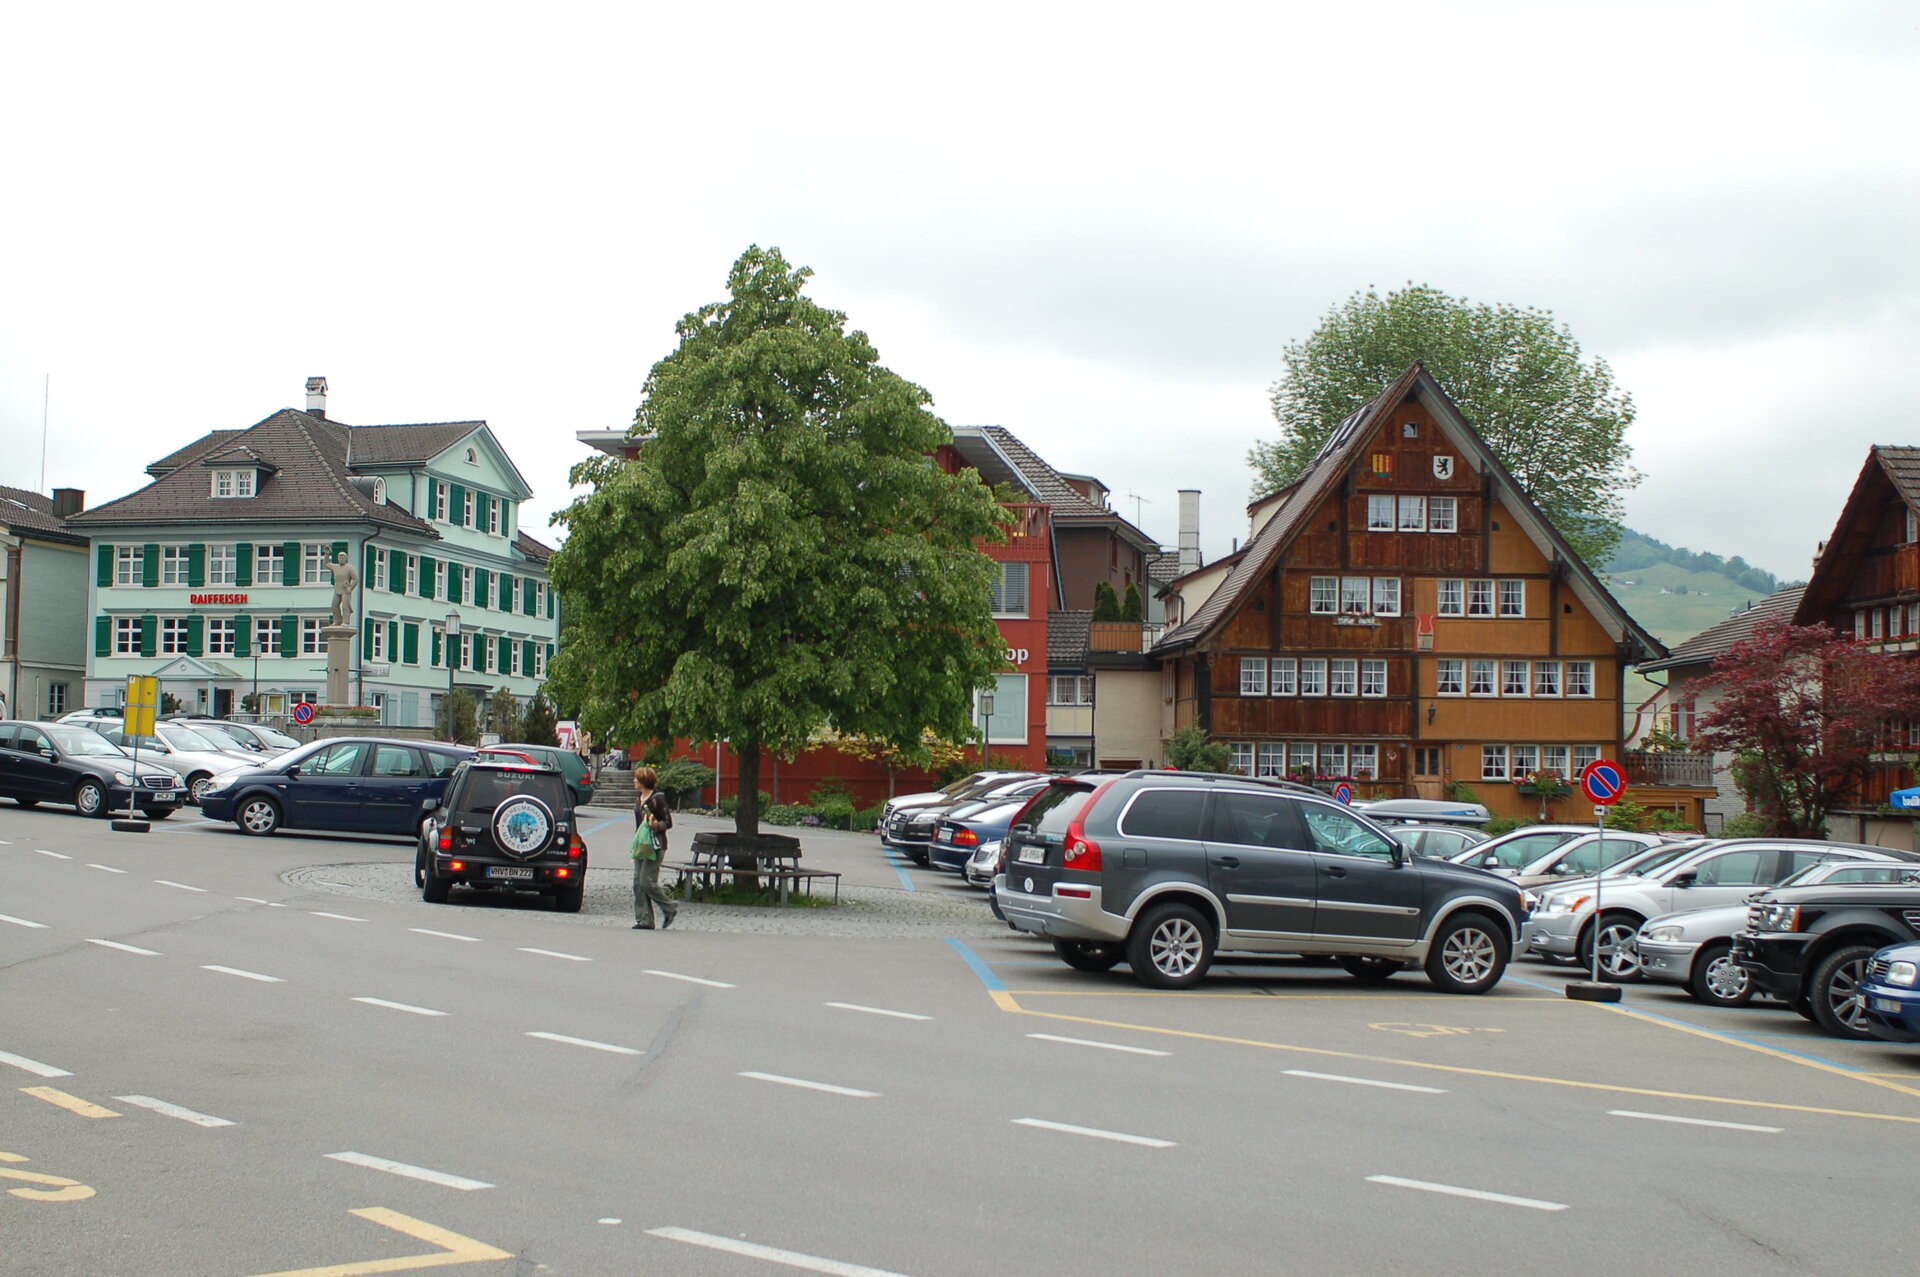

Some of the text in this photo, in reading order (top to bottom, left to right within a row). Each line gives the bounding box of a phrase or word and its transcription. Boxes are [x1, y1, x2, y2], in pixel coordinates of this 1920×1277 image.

[190, 593, 248, 605] RAIFFEISEN
[1002, 648, 1029, 665] op
[497, 771, 535, 780] SUZUKI
